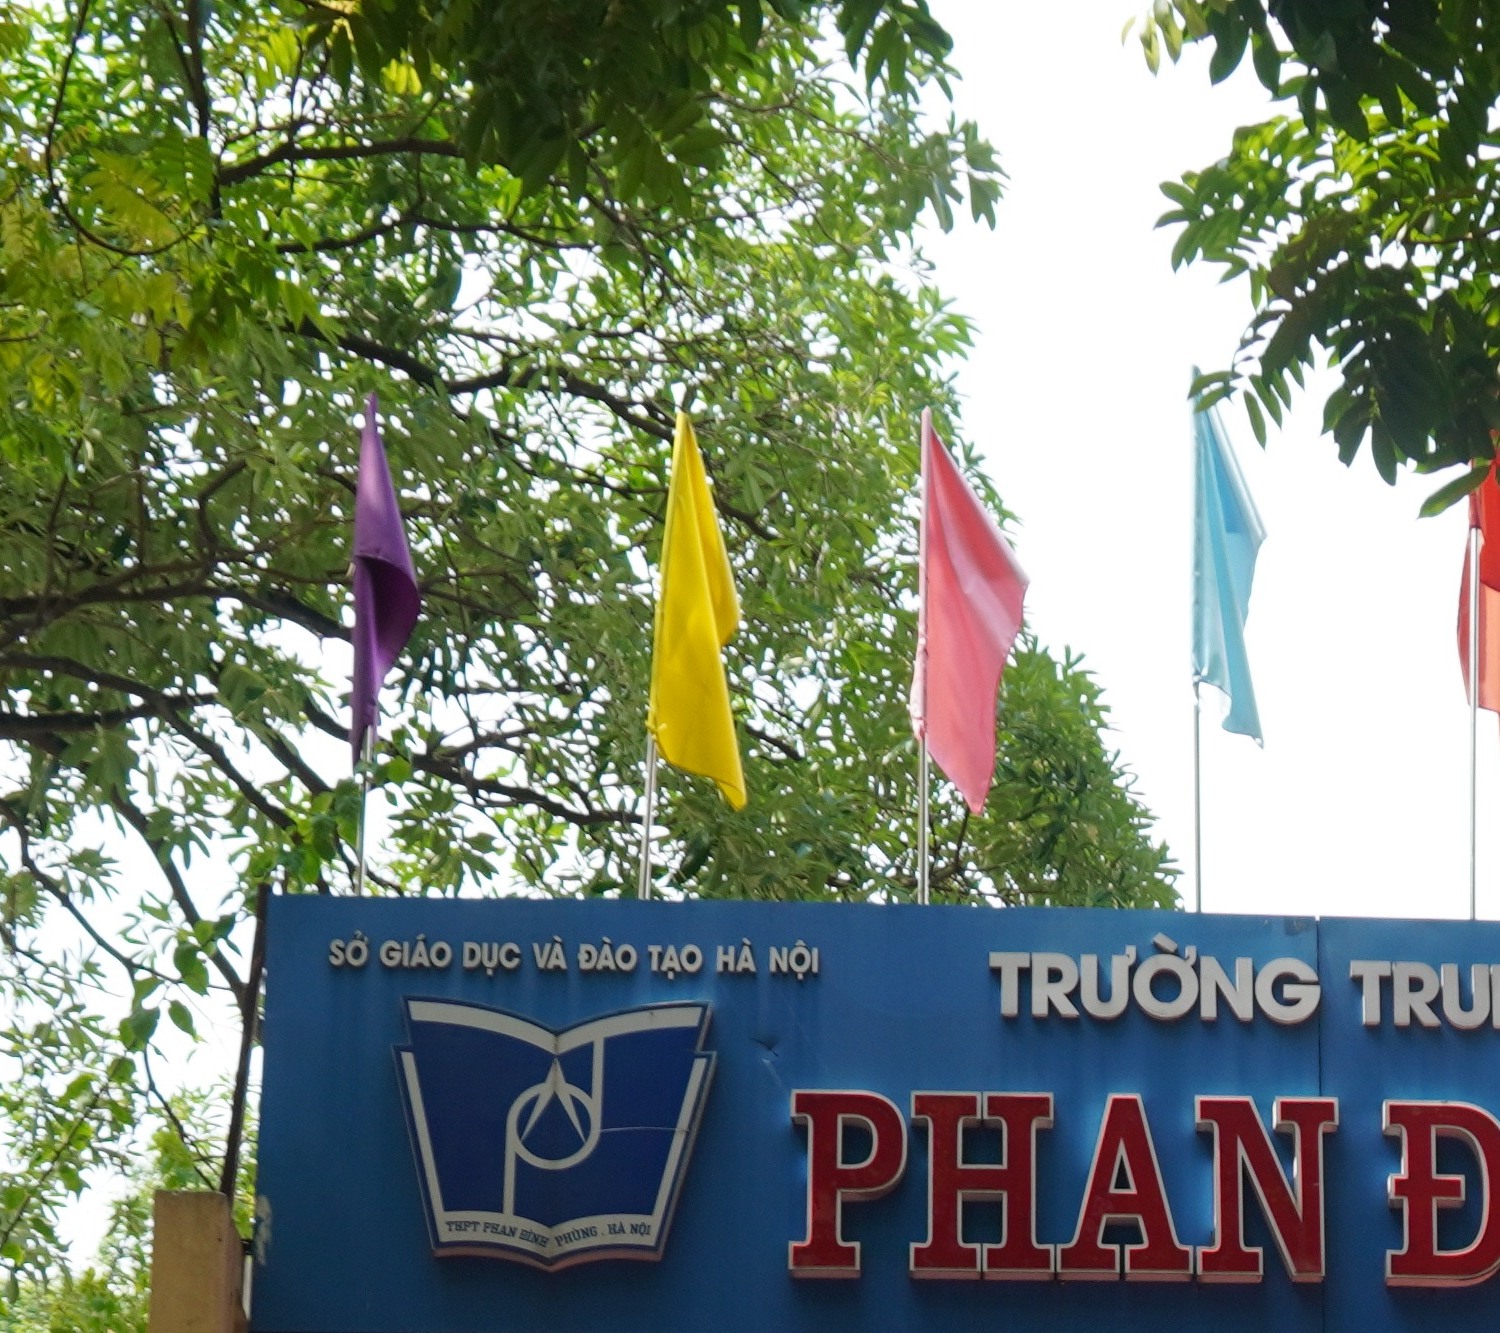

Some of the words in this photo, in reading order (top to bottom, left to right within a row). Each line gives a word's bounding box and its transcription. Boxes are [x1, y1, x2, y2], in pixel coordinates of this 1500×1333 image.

[329, 930, 369, 968] SỞ
[379, 934, 452, 969] GIÁO
[463, 941, 521, 976] DỤC
[533, 935, 568, 970] VÀ
[577, 937, 638, 972] ĐÀO
[648, 944, 703, 980] TẠO
[716, 938, 757, 974] HÀ
[769, 939, 819, 980] NỘI
[989, 936, 1320, 1028] TRƯỜNG
[788, 1089, 1340, 1283] PHAN
